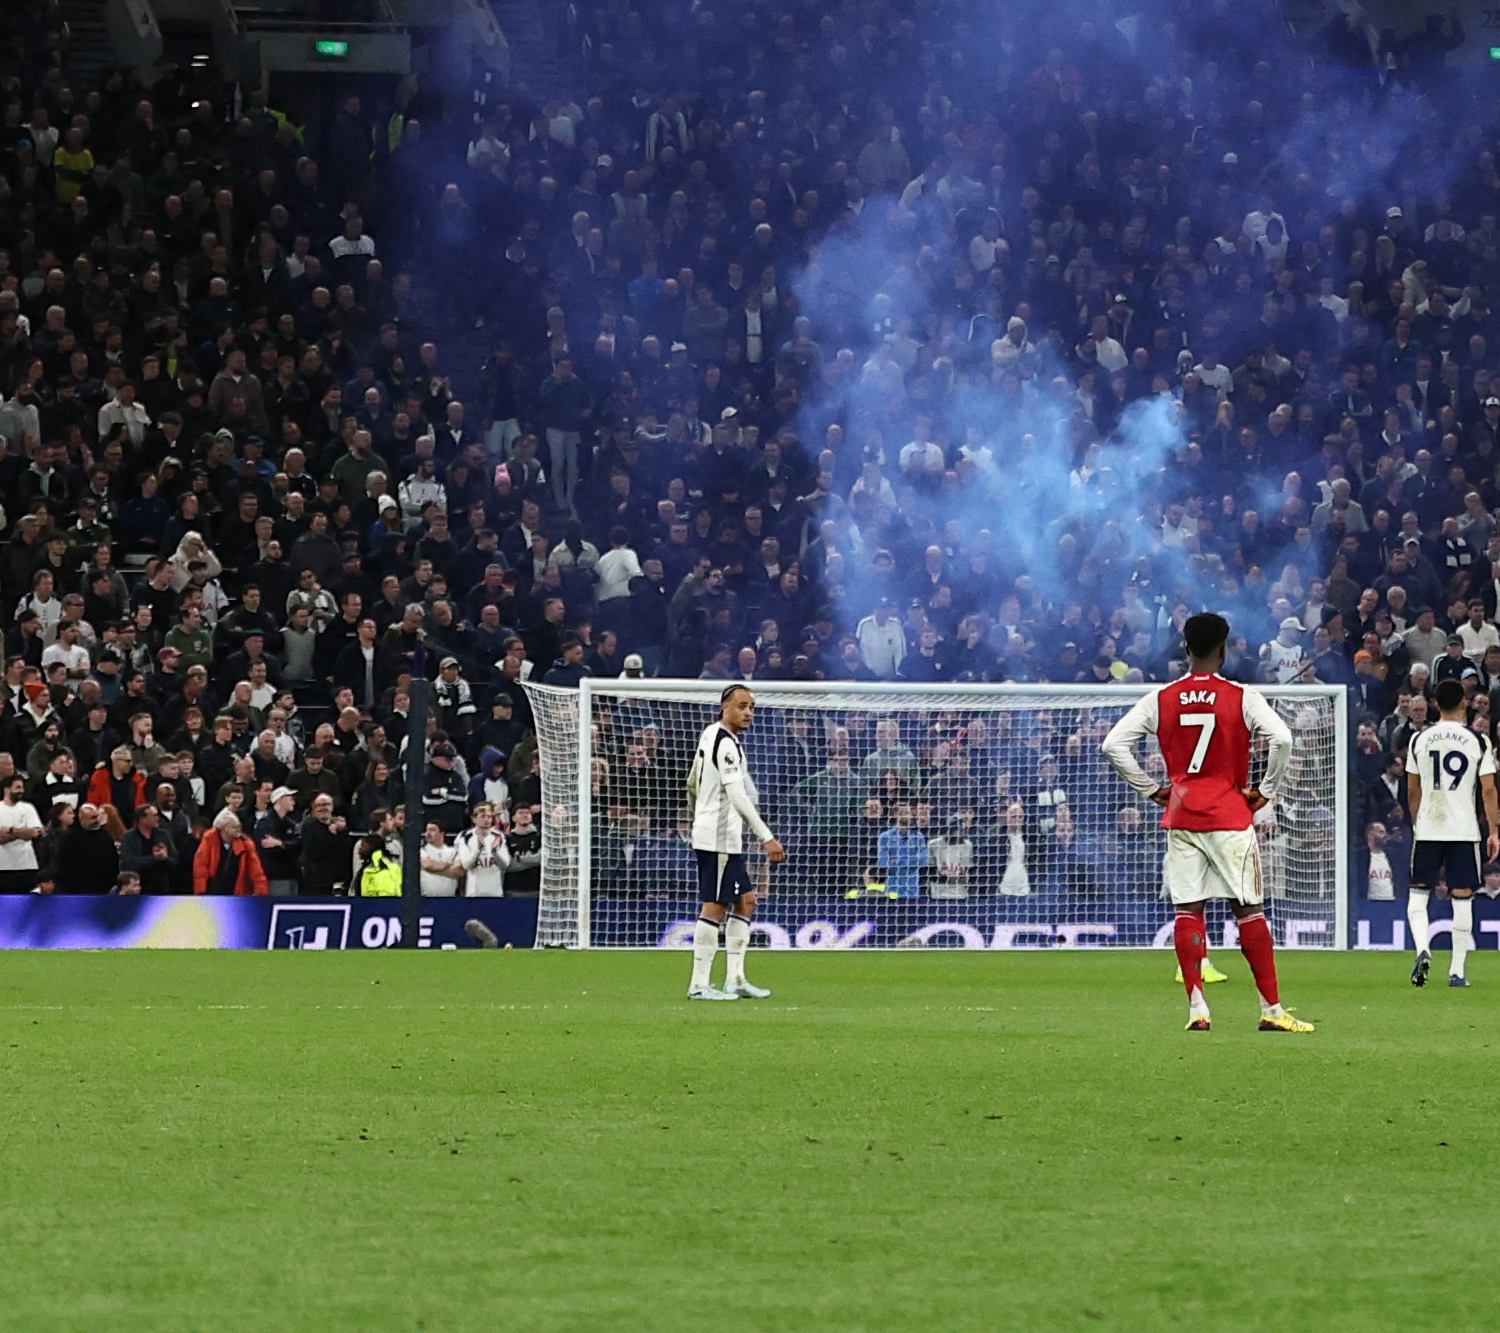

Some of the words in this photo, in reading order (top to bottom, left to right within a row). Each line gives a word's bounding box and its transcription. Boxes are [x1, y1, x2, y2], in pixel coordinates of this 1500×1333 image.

[1179, 689, 1217, 706] SAKA
[1179, 712, 1218, 775] 7
[1426, 732, 1470, 747] SOLANKE
[1428, 750, 1469, 791] 19
[1369, 869, 1392, 880] AIA
